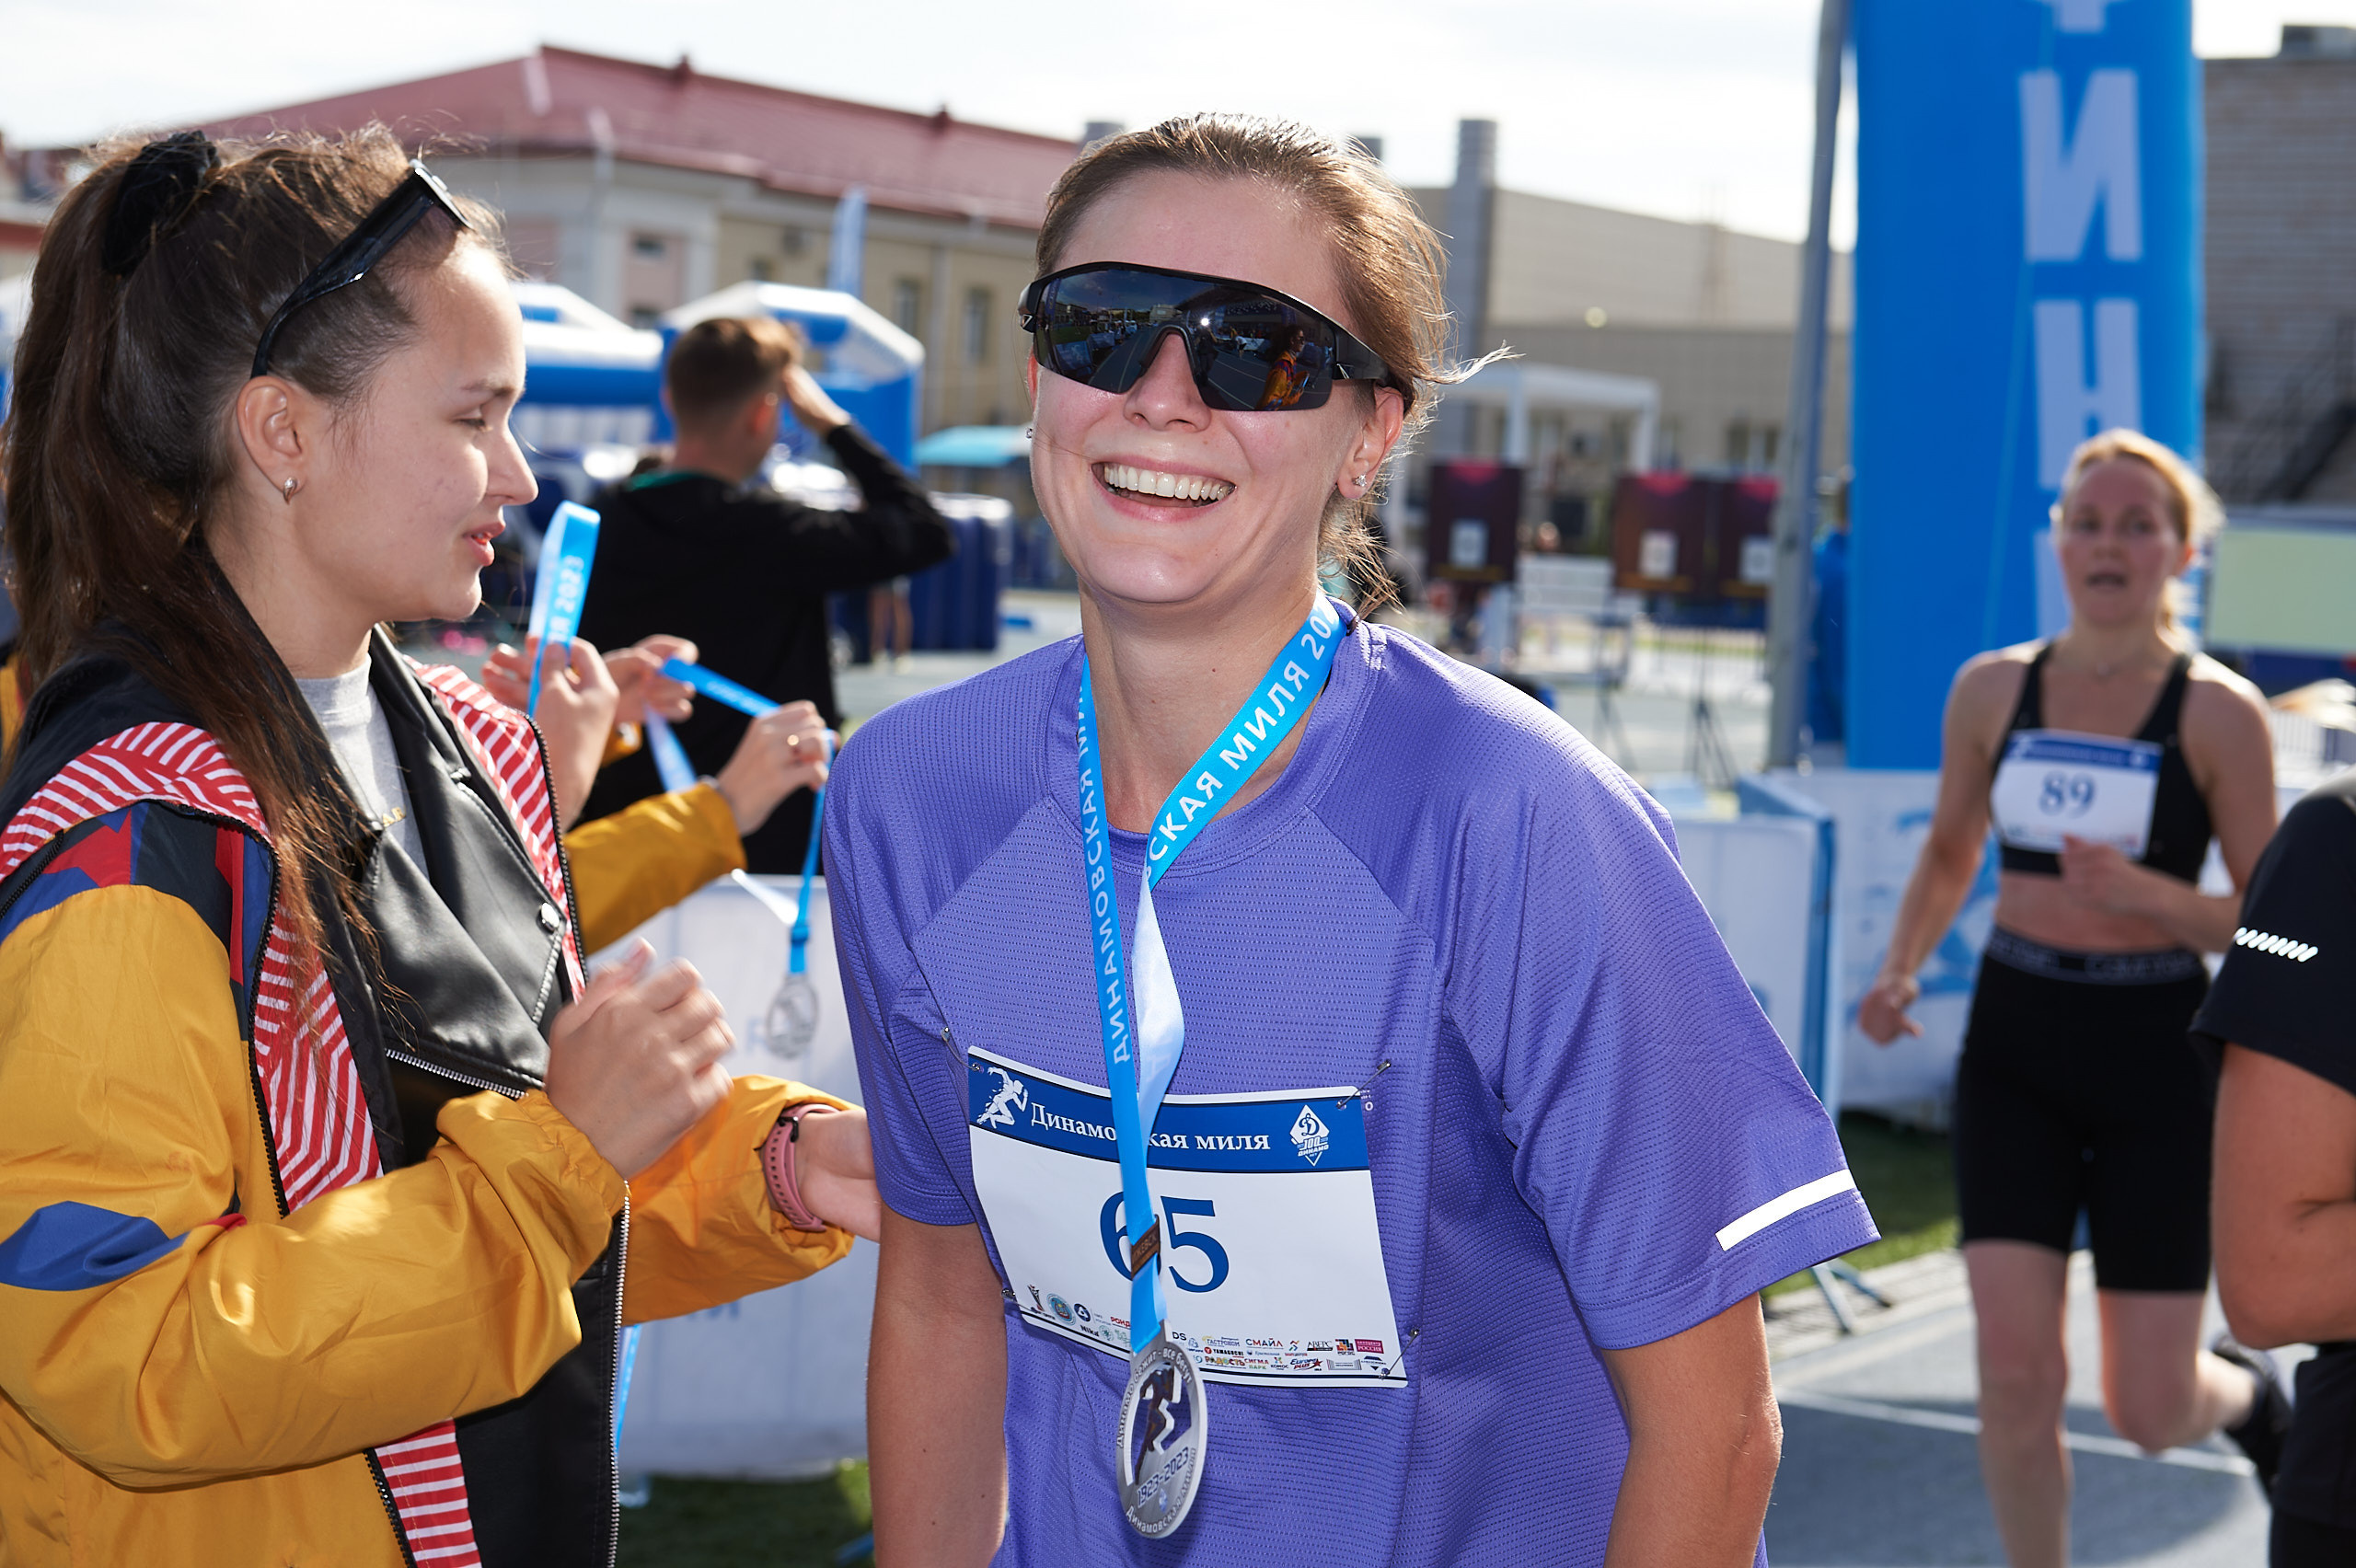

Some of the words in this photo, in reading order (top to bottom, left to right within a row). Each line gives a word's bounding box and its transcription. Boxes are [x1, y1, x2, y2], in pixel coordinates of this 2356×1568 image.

[1219, 660, 1310, 770] МИЛЯ
[2038, 770, 2096, 820] 89
[1080, 768, 1131, 1065] ДИНАМОВСКАЯ
[1031, 1101, 1189, 1149] Динамокая
[1195, 1134, 1271, 1151] миля
[1205, 1355, 1246, 1366] РАДОСТЬ
[1245, 1337, 1284, 1347] СМАЙЛ
[1115, 1383, 1135, 1449] Динамо
[1162, 1347, 1177, 1361] все
[1137, 1446, 1190, 1509] 1923-2023
